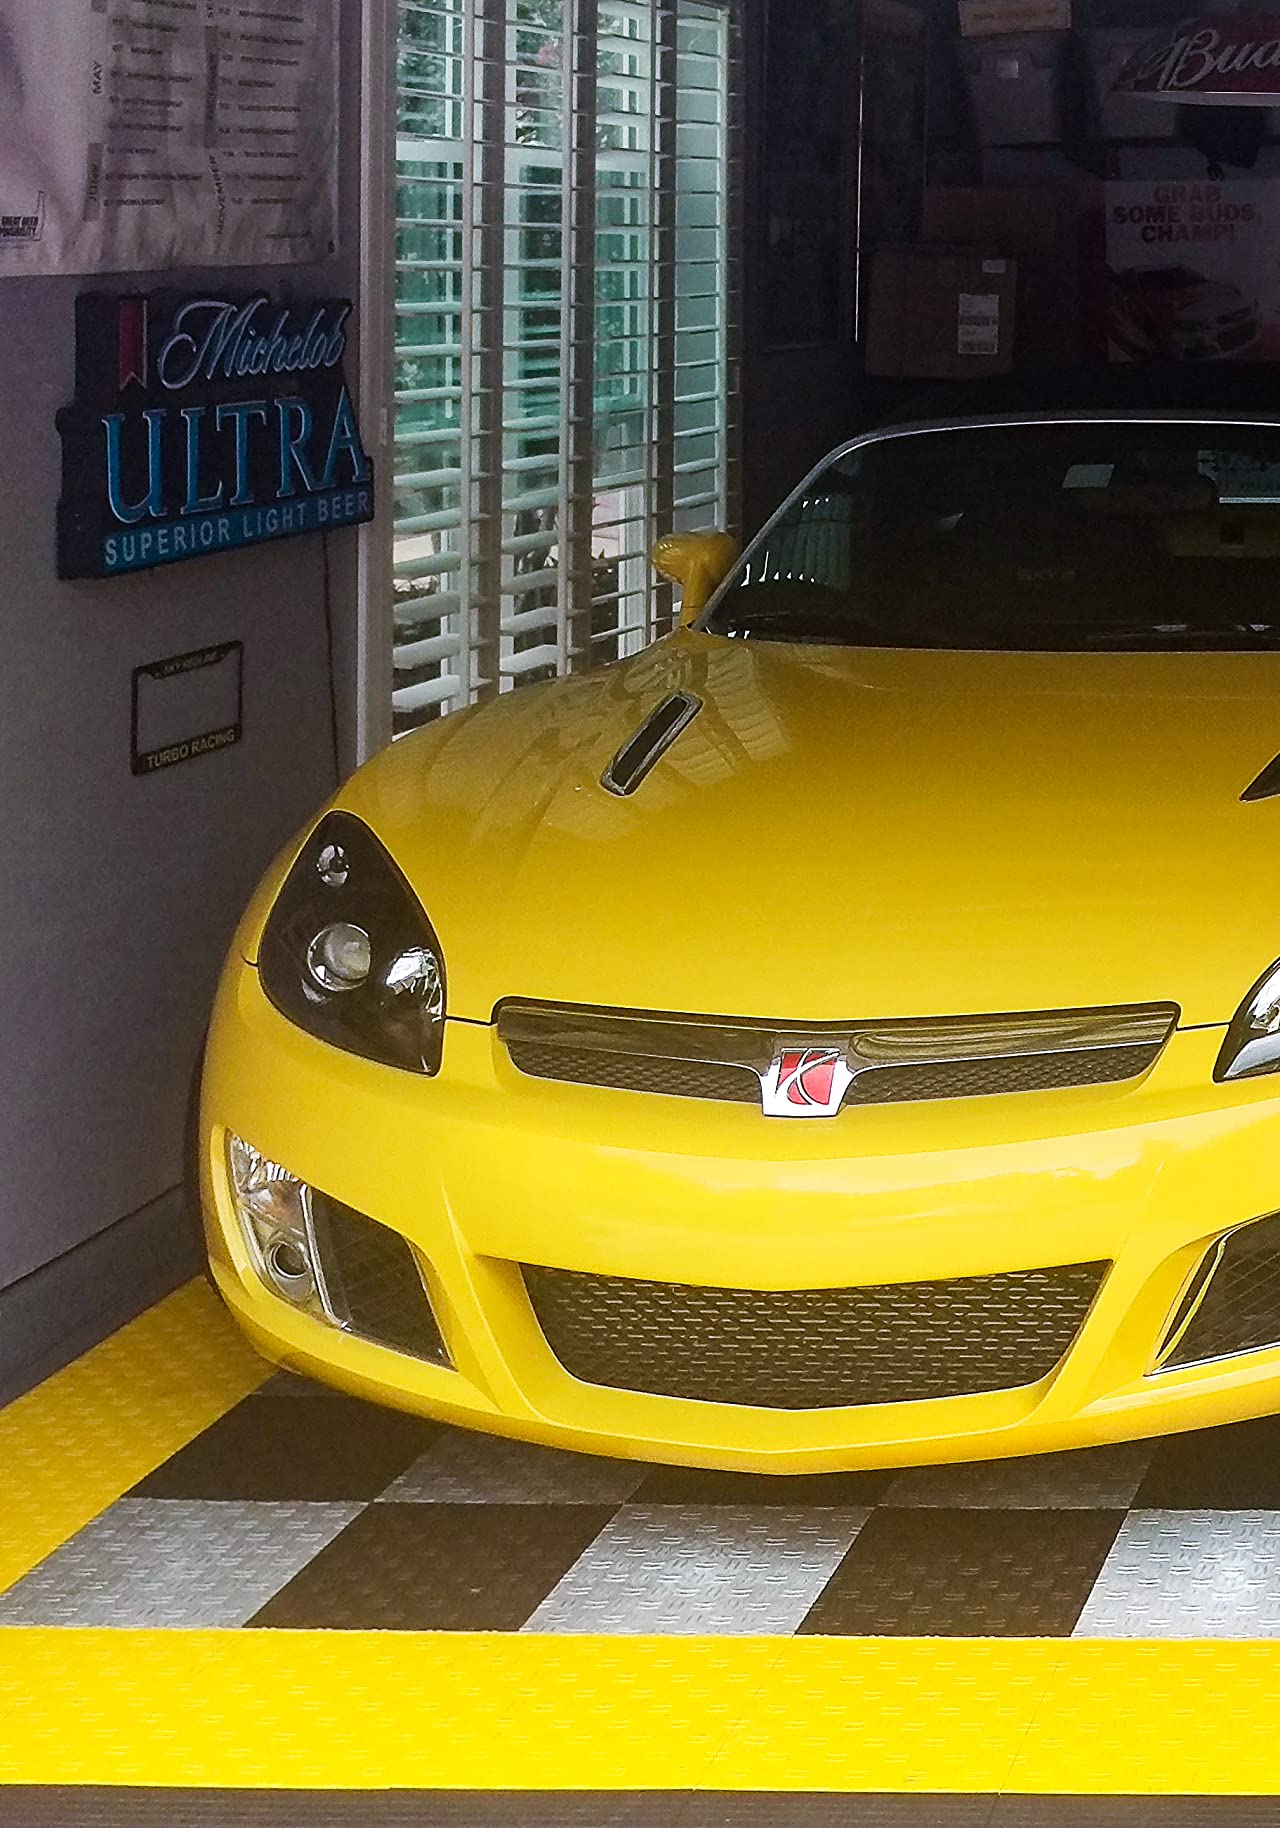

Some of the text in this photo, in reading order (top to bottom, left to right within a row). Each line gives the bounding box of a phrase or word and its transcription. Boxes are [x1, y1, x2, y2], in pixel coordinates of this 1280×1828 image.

[92, 61, 103, 95] MAY
[208, 154, 226, 235] NOVEMBER
[1154, 184, 1222, 203] GRAB
[1113, 206, 1182, 225] SOME
[1141, 225, 1235, 243] CHAMP!
[157, 299, 347, 390] Michelob
[101, 385, 370, 524] ULTRA
[104, 491, 369, 566] SUPERIOR LIGHT BEER
[147, 729, 235, 768] TURBO RACING
